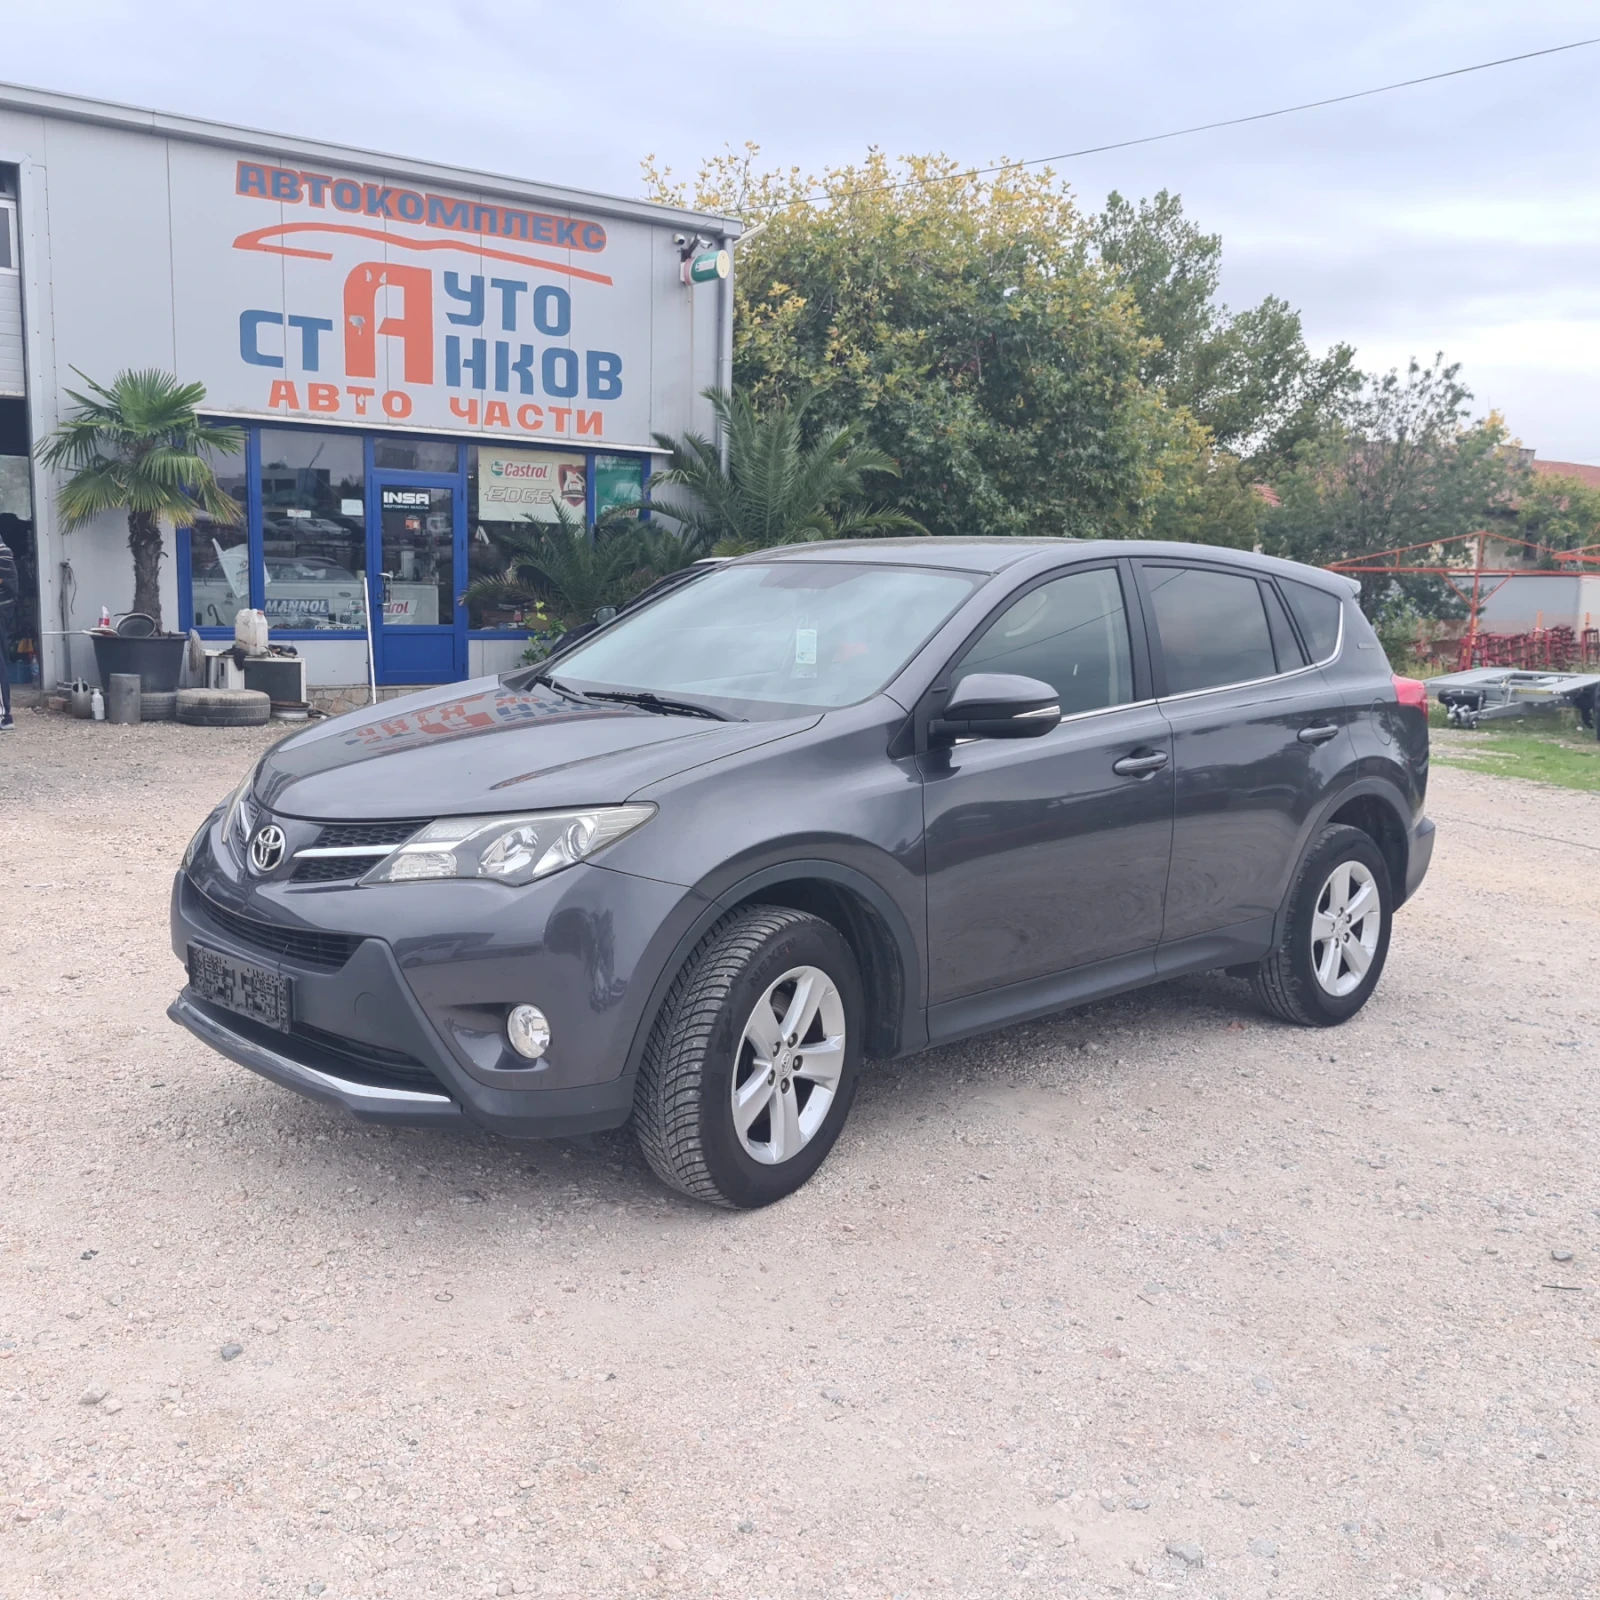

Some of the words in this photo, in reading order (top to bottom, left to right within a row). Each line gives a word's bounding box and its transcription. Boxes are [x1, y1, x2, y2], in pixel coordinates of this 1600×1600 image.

[236, 161, 606, 253] АВТОКОМПЛЕКС
[268, 380, 413, 419] АВТО
[449, 397, 603, 436] ЧАСТИ
[504, 463, 548, 478] Castrol
[383, 491, 430, 505] INSA
[484, 486, 554, 504] EDGE
[265, 600, 327, 614] MANNOL
